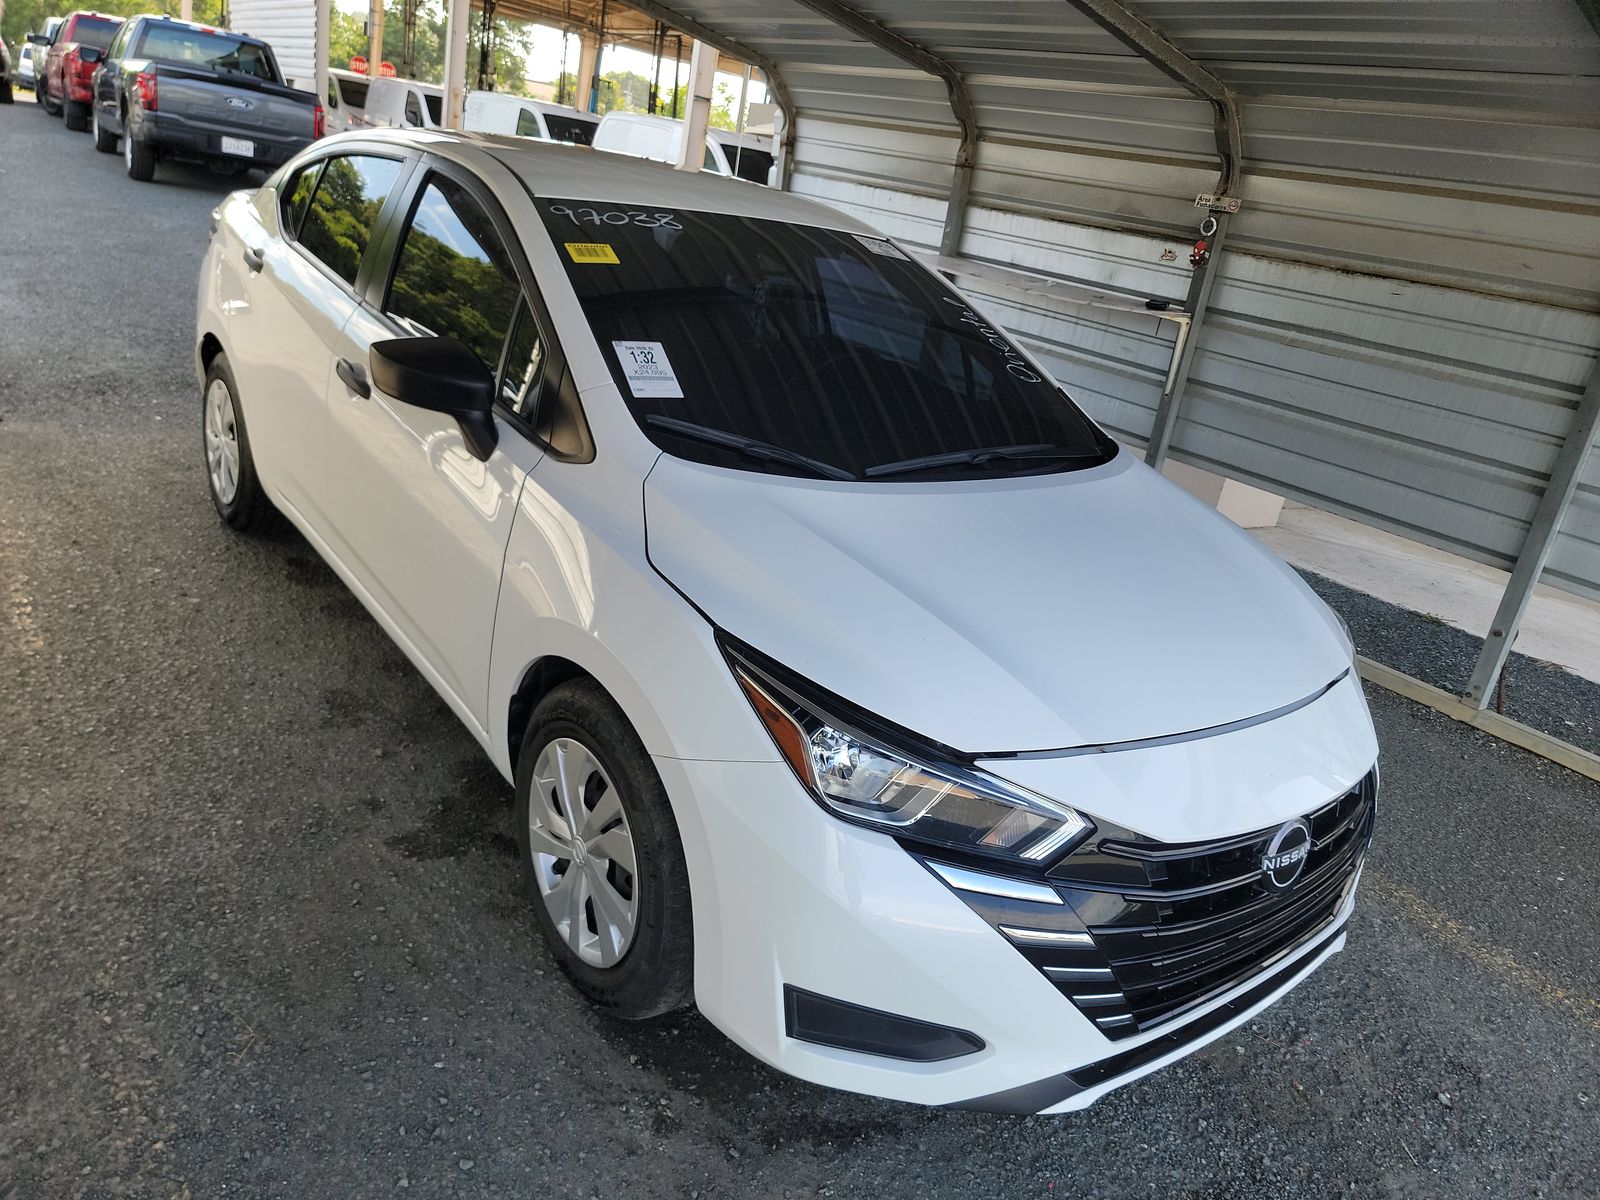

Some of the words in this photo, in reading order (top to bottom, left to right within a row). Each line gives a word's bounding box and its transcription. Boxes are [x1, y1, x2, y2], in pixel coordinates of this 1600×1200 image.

[352, 60, 369, 71] STOP
[550, 205, 683, 230] 97038
[630, 351, 657, 364] 1:32
